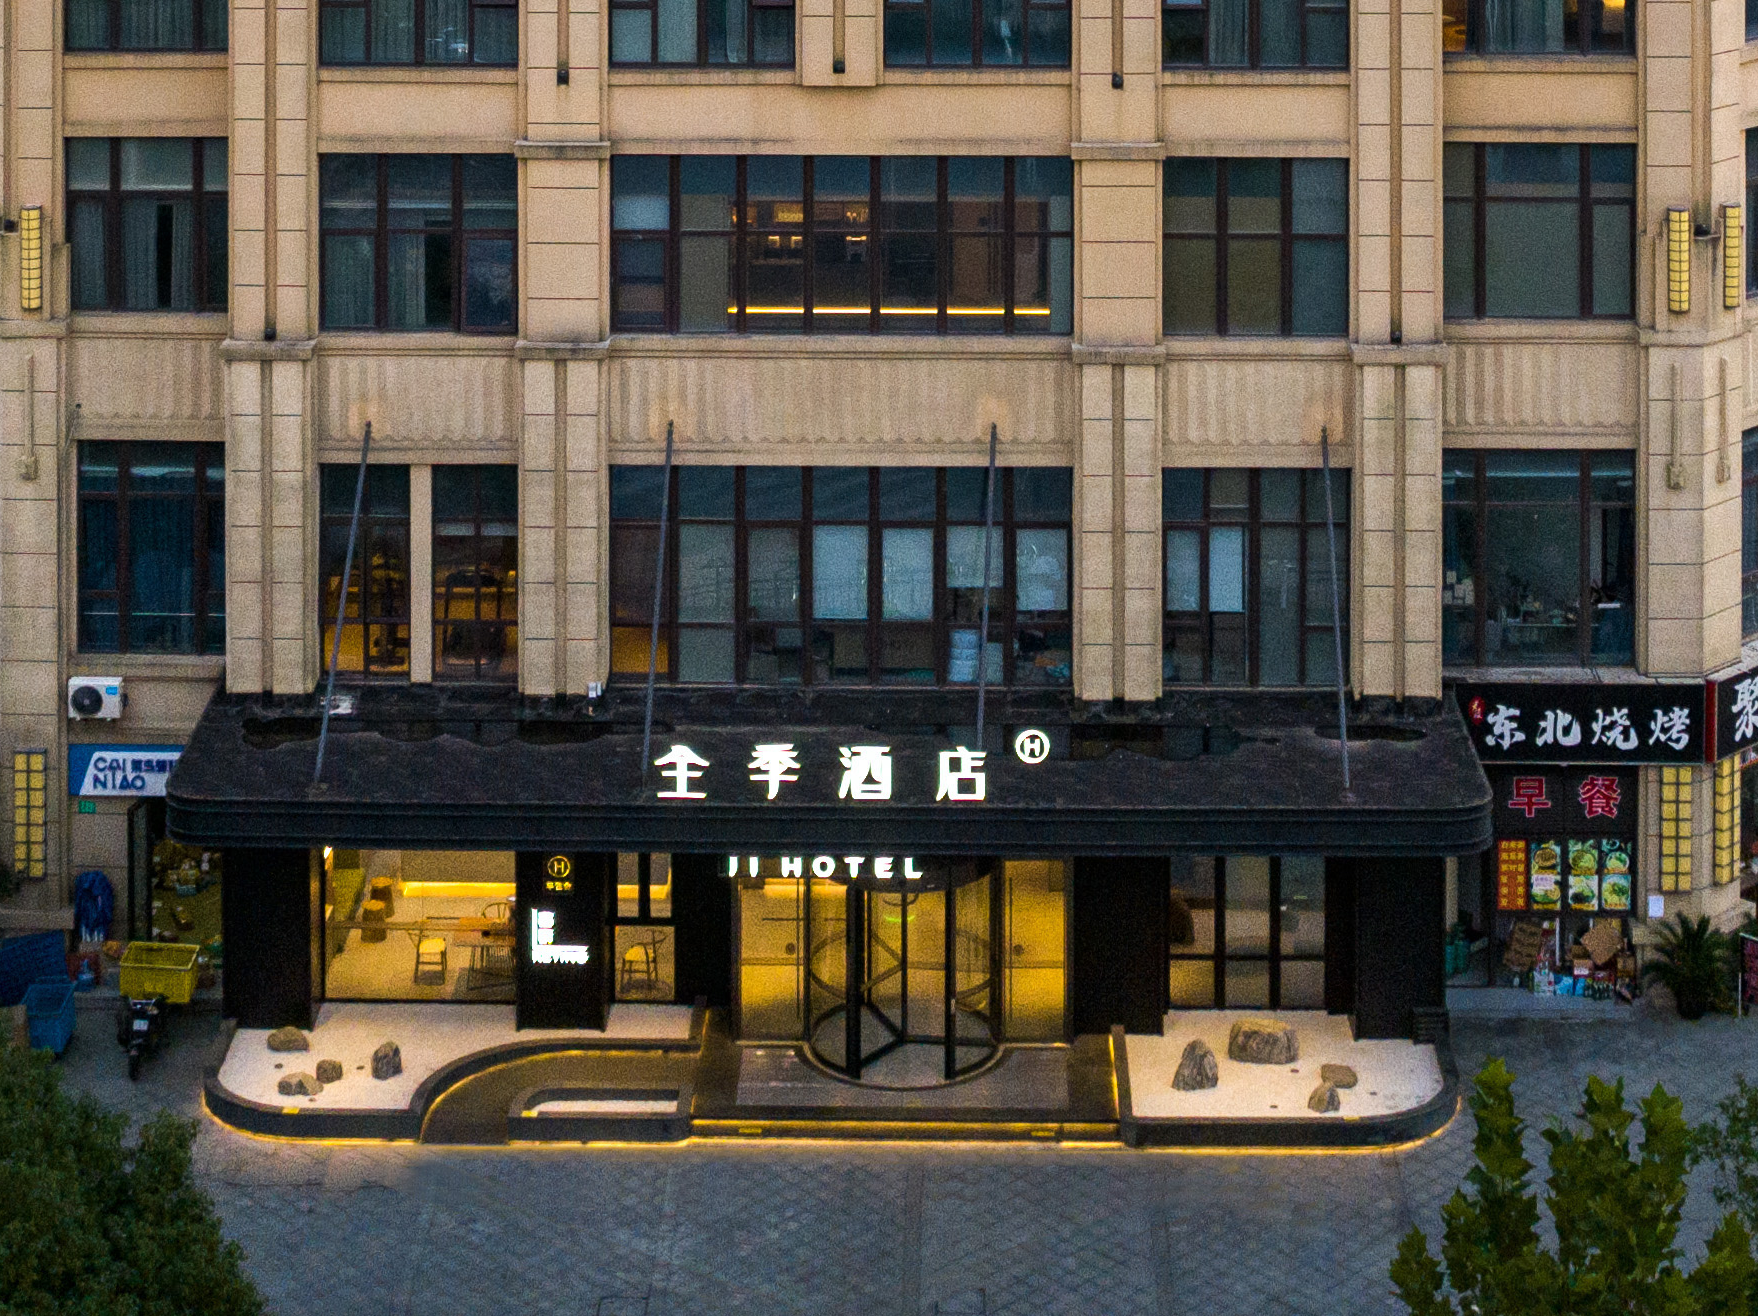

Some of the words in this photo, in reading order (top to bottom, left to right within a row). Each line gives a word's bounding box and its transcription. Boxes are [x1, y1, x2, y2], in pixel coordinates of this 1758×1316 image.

[1485, 704, 1692, 751] 东北烧烤
[654, 742, 987, 802] 全季酒店
[1508, 775, 1622, 819] 早餐
[728, 855, 759, 878] JI
[781, 855, 924, 879] HOTEL
